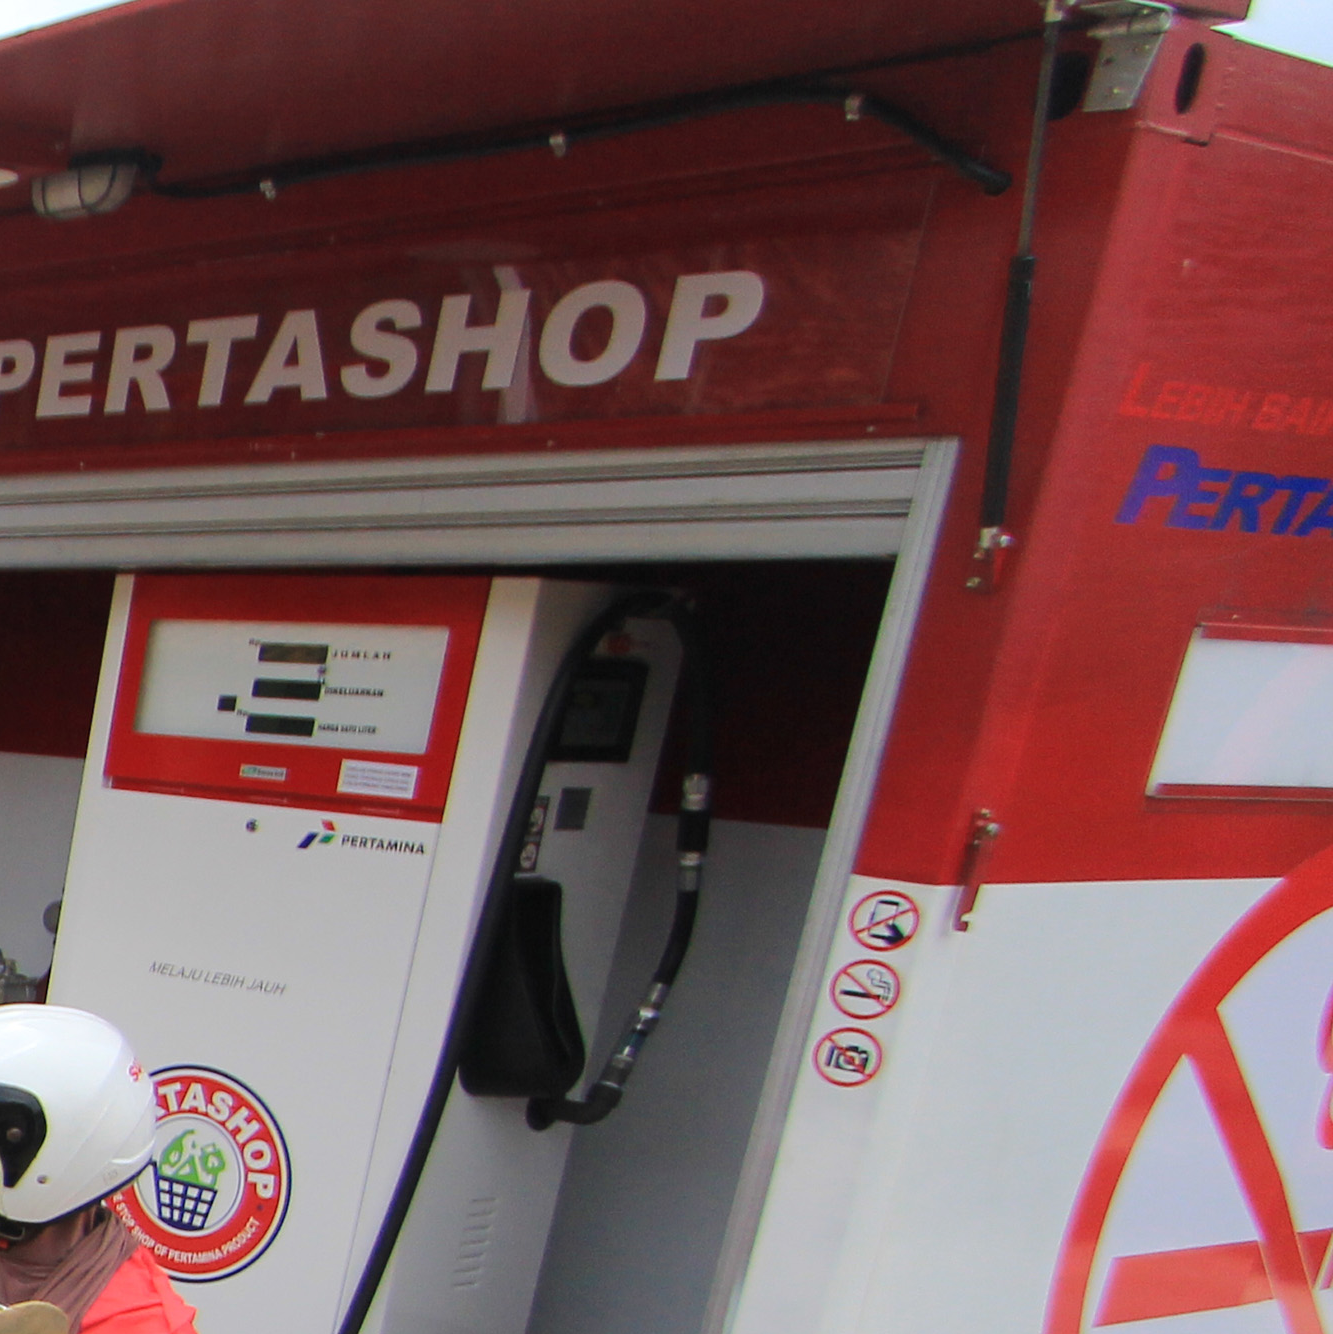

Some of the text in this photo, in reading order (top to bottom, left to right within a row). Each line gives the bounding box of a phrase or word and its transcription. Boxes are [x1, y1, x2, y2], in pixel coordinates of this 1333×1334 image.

[341, 833, 425, 855] PERTAMINA
[148, 960, 288, 997] MELAJU LEBIH JAUH
[155, 1081, 276, 1200] TASHOP
[115, 1202, 260, 1266] STOP SHOP OF PERTAMINA PRODUCT
